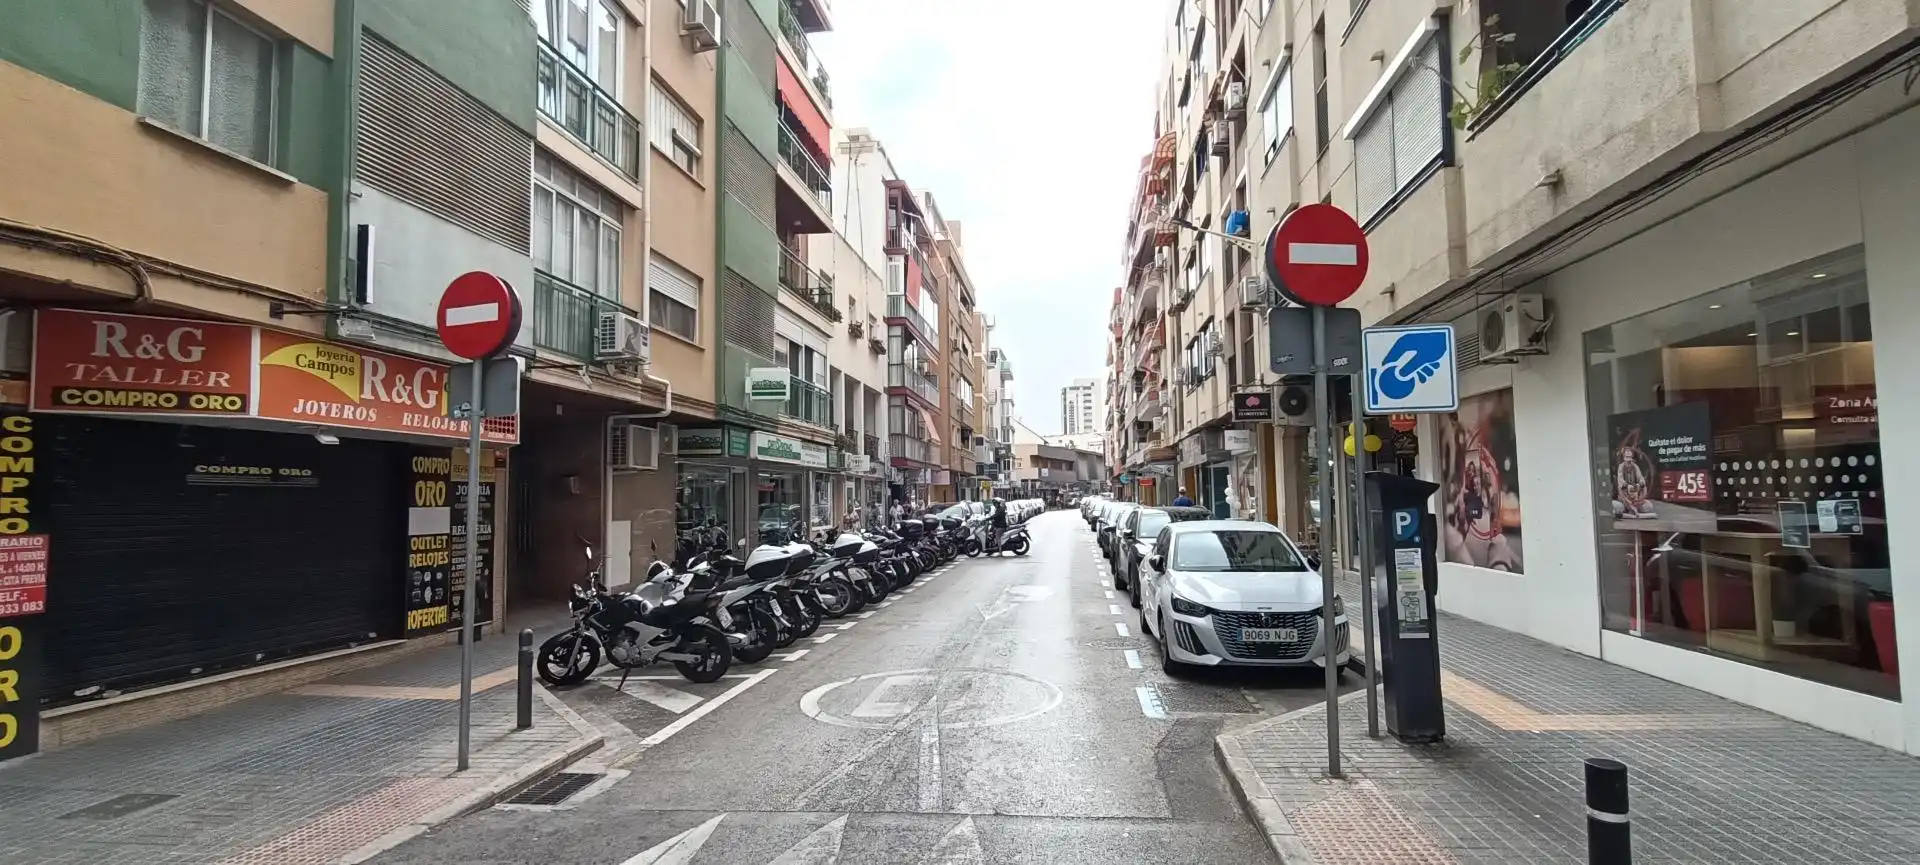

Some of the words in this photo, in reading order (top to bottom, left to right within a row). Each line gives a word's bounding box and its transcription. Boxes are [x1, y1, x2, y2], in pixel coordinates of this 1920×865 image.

[89, 320, 206, 363] R&G
[65, 363, 231, 388] TALLER
[295, 353, 355, 379] Campos
[360, 355, 438, 409] R&G
[61, 389, 178, 408] COMPRO
[189, 394, 242, 410] ORO
[1829, 397, 1861, 408] Zona
[293, 399, 377, 421] JOYEROS
[402, 412, 484, 435] RELOJERS
[0, 416, 34, 534] COMPRO
[195, 464, 273, 475] COMPRO
[278, 468, 312, 476] ORO
[412, 456, 450, 475] COMPRO
[415, 480, 446, 507] ORO
[1677, 472, 1705, 494] 45€
[1395, 511, 1412, 535] P
[410, 536, 448, 551] OUTLET
[409, 551, 449, 568] RELOJES
[22, 601, 44, 612] 083
[407, 605, 448, 630] ¡OFERTA!
[1244, 630, 1270, 640] 9069
[1274, 630, 1295, 640] NJG
